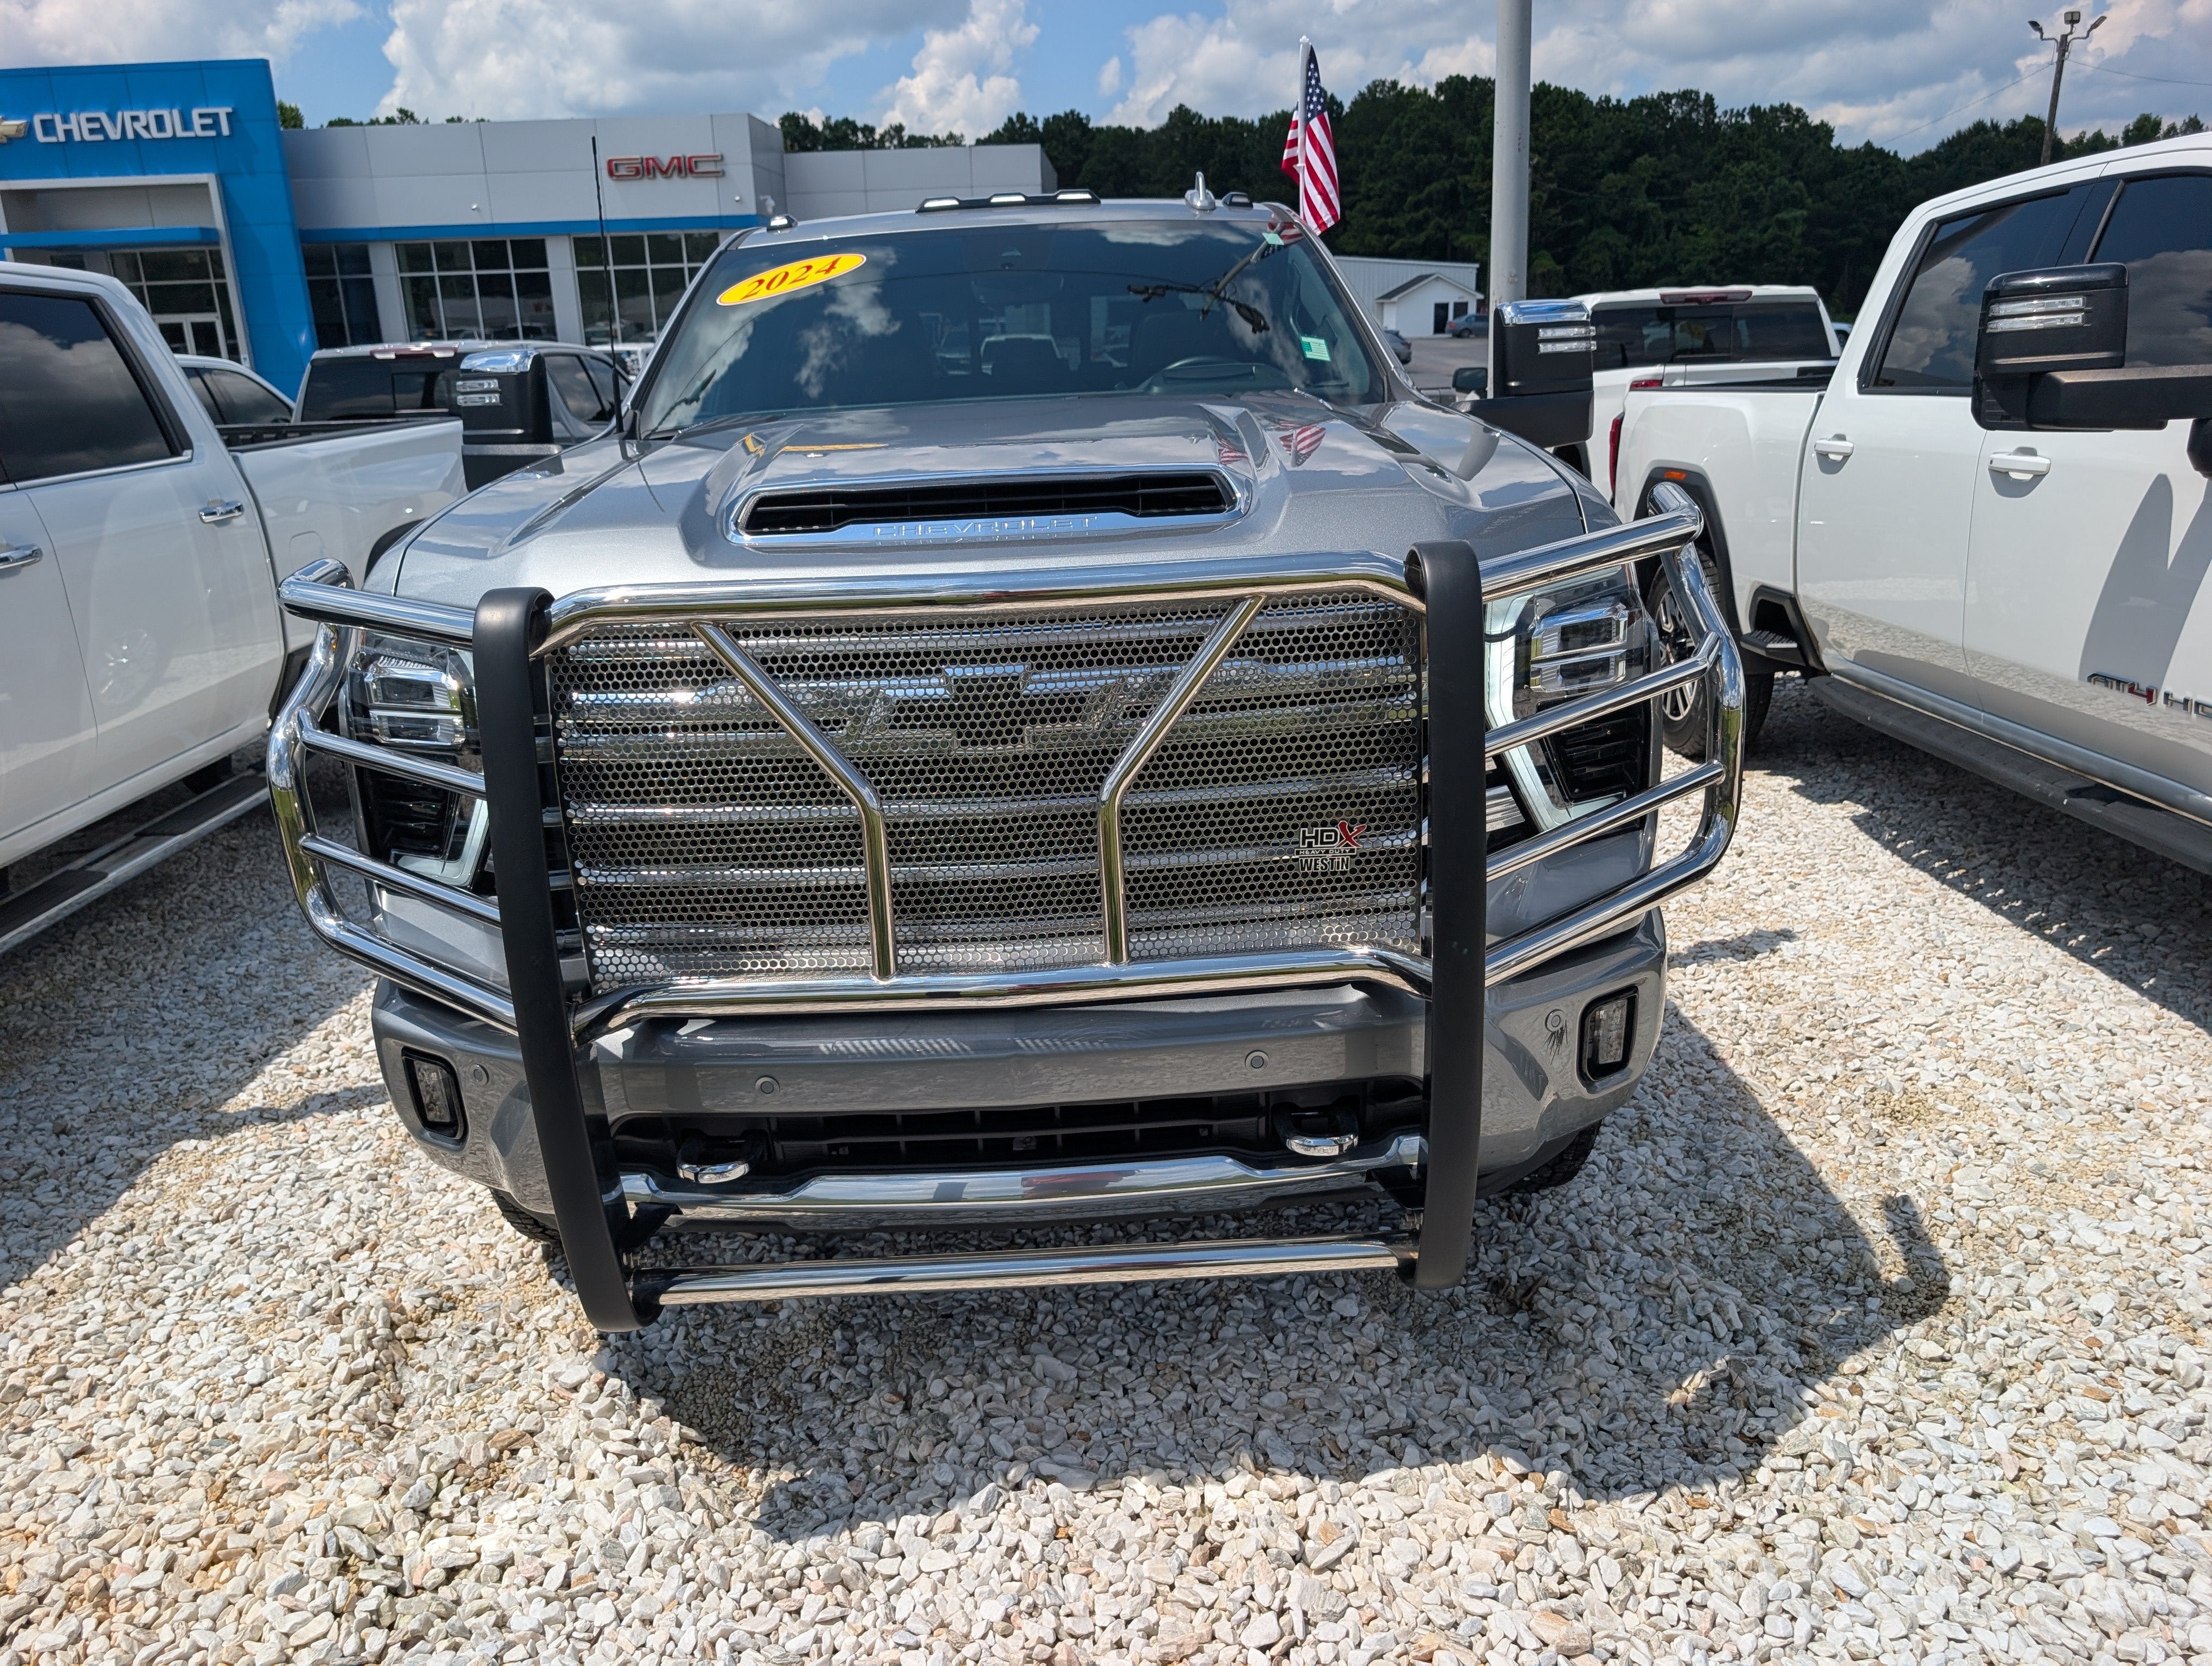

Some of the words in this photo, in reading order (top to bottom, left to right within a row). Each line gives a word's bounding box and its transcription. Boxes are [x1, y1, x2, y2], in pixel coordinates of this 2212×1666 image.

[33, 106, 234, 144] CHEVROLET
[606, 153, 724, 180] GMC
[740, 256, 842, 301] 2024
[873, 516, 1097, 537] CHEVROLET
[2087, 673, 2157, 706] AT4
[1300, 821, 1367, 849] HDX
